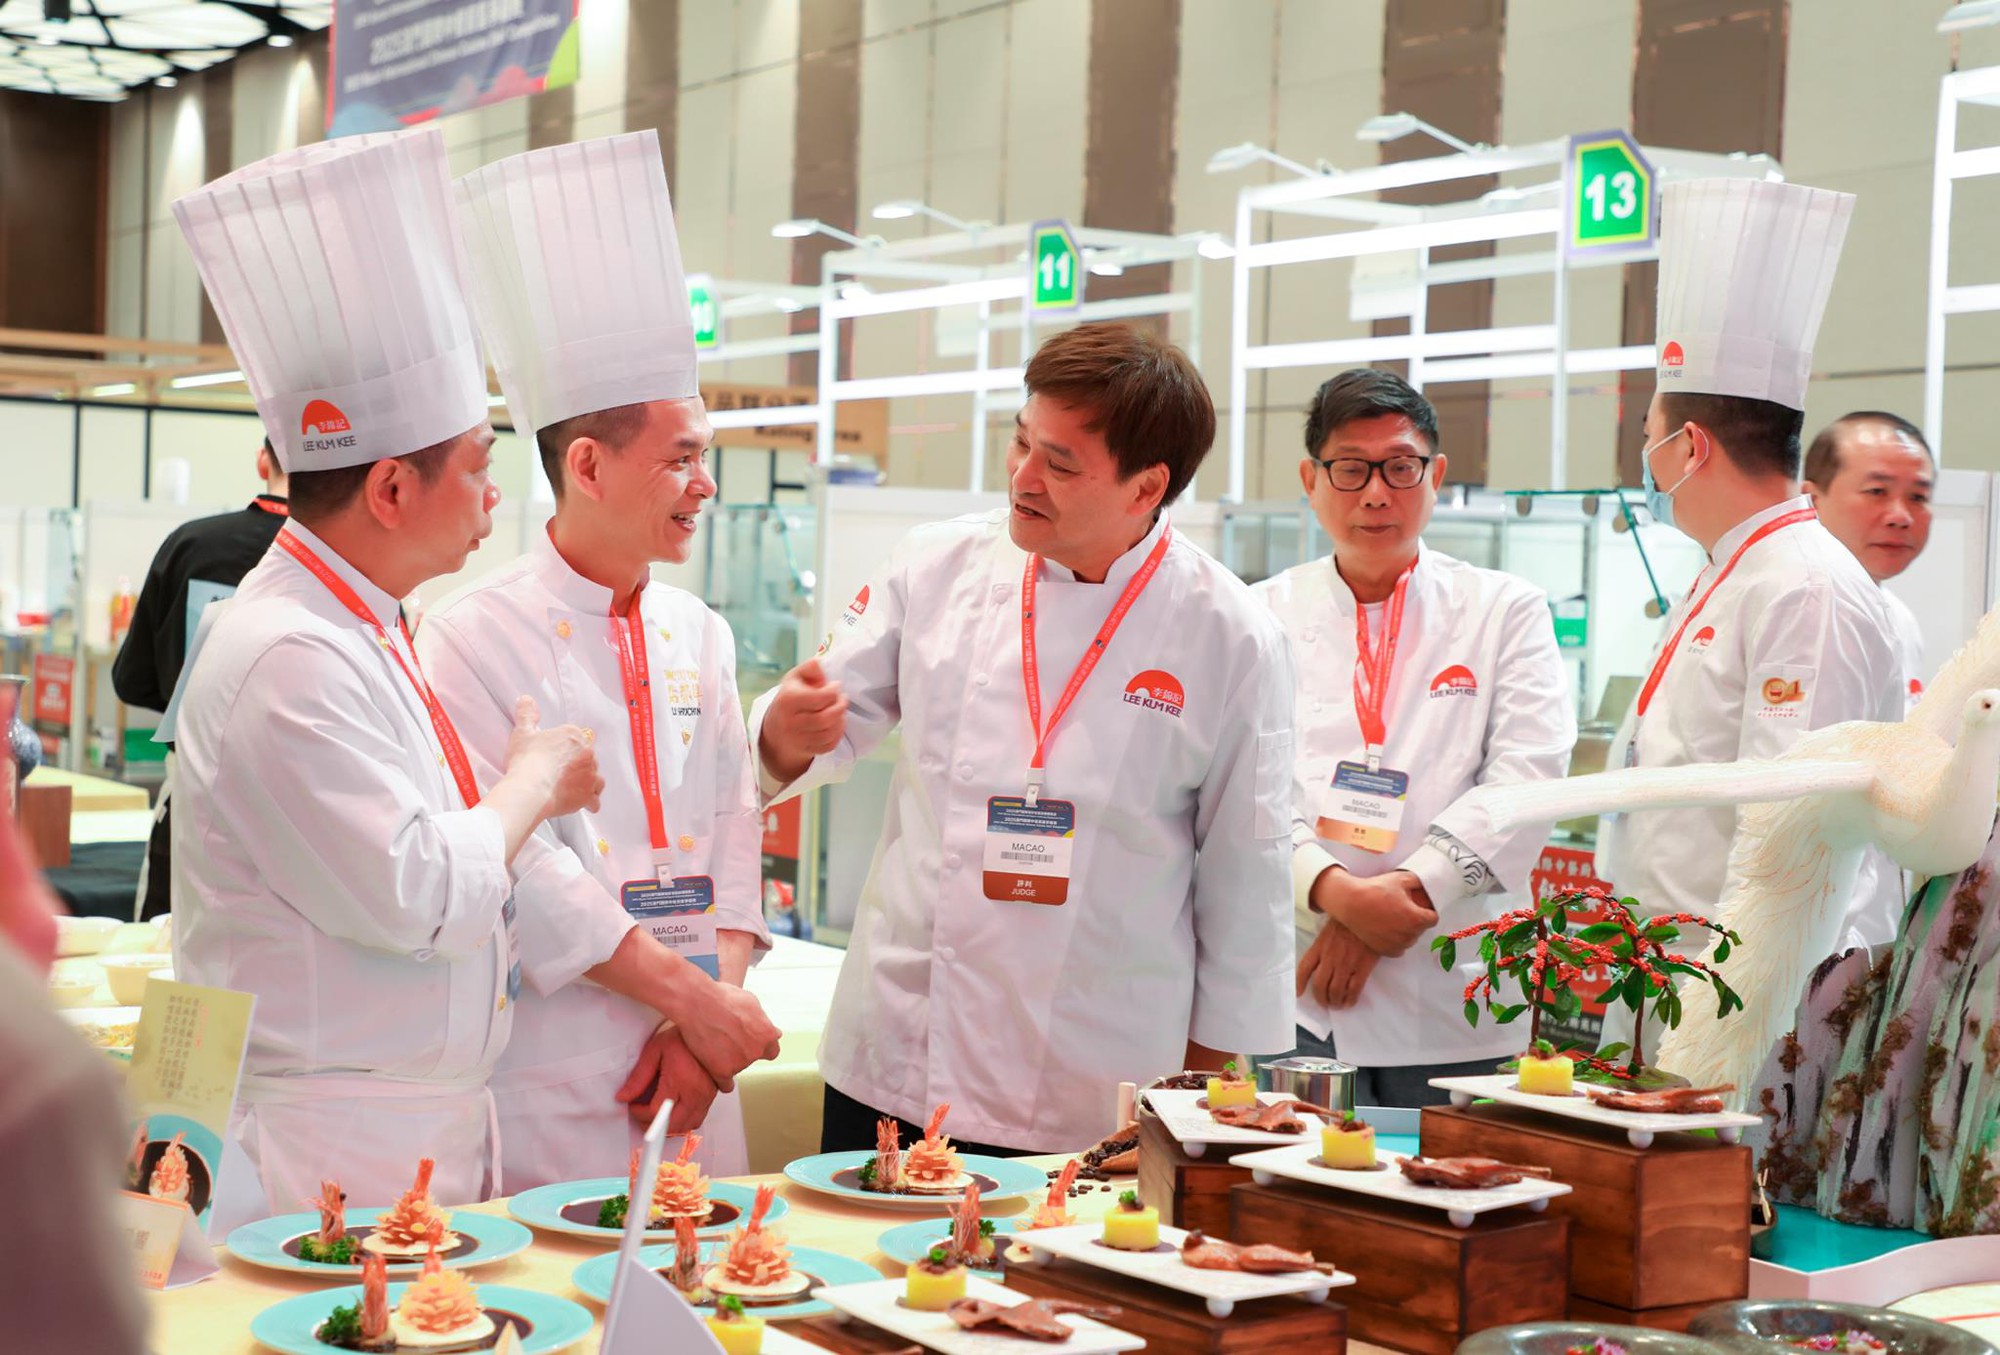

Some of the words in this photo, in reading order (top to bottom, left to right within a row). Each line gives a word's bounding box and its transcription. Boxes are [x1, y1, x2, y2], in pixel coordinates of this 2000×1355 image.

[1585, 170, 1636, 222] 13
[1040, 251, 1071, 291] 11
[303, 440, 315, 452] LEE
[316, 439, 336, 451] KUM
[336, 435, 357, 448] KEE
[1123, 693, 1142, 706] LEE
[1142, 697, 1166, 712] KUM
[1165, 704, 1182, 719] KEE
[1011, 843, 1046, 853] MACAO
[1011, 888, 1037, 897] JUDGE
[652, 925, 688, 936] MACAO
